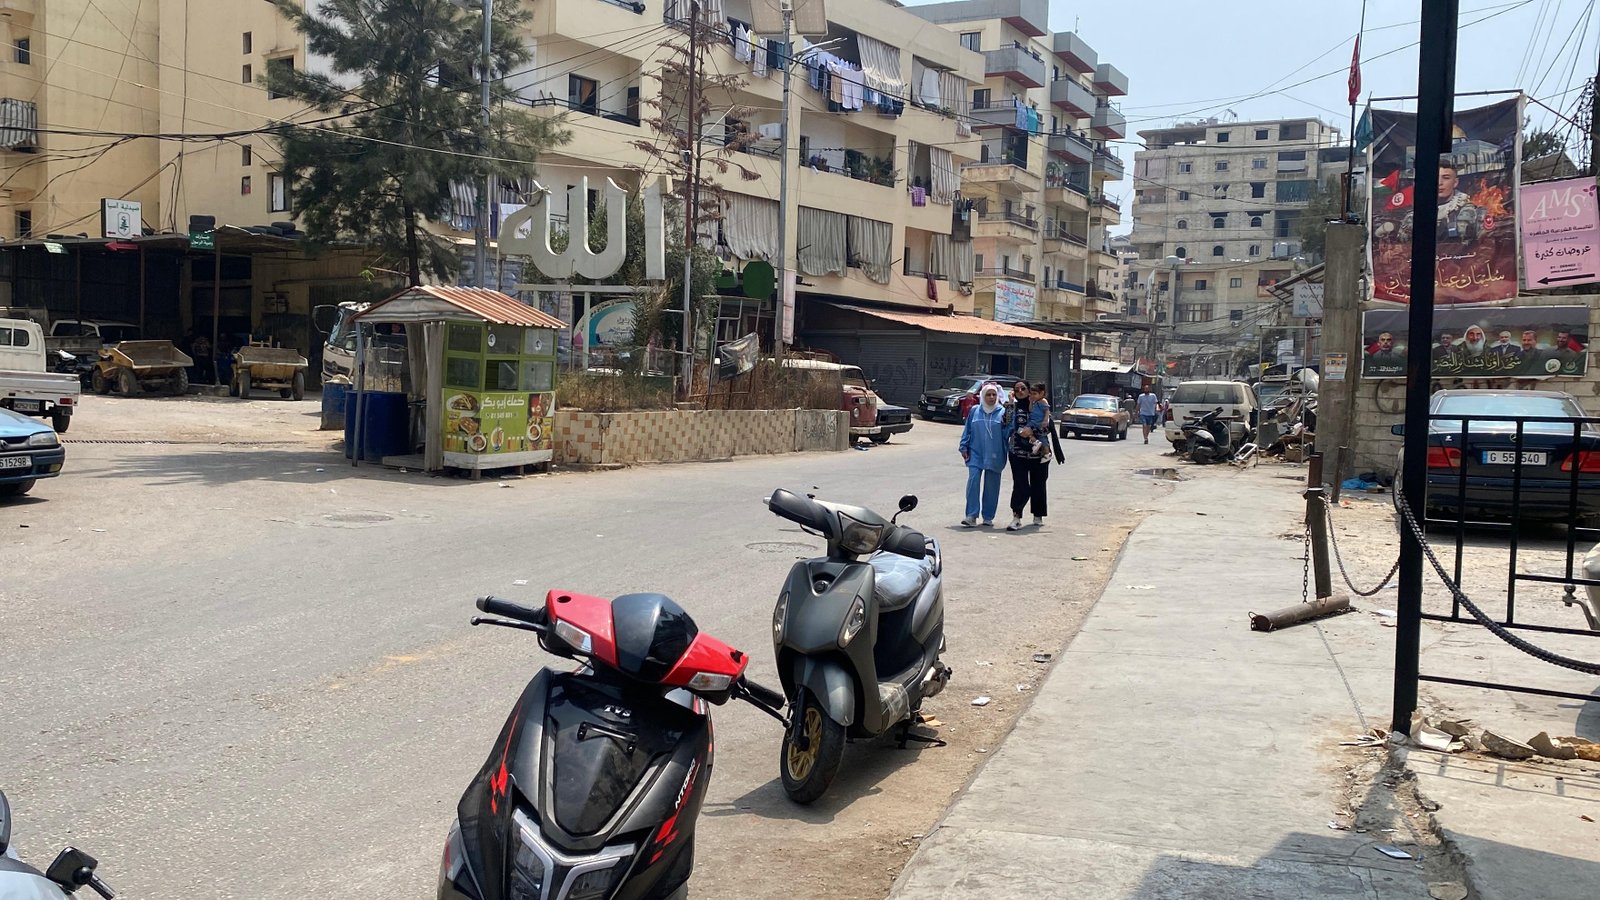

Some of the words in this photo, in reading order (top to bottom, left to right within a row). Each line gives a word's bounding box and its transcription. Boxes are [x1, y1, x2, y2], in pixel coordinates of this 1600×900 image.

[1528, 187, 1587, 220] AMS
[499, 176, 673, 280] الله
[1535, 247, 1554, 261] كثيرة
[1556, 246, 1591, 258] عروضات
[1490, 453, 1497, 462] G
[1502, 453, 1540, 463] 55540
